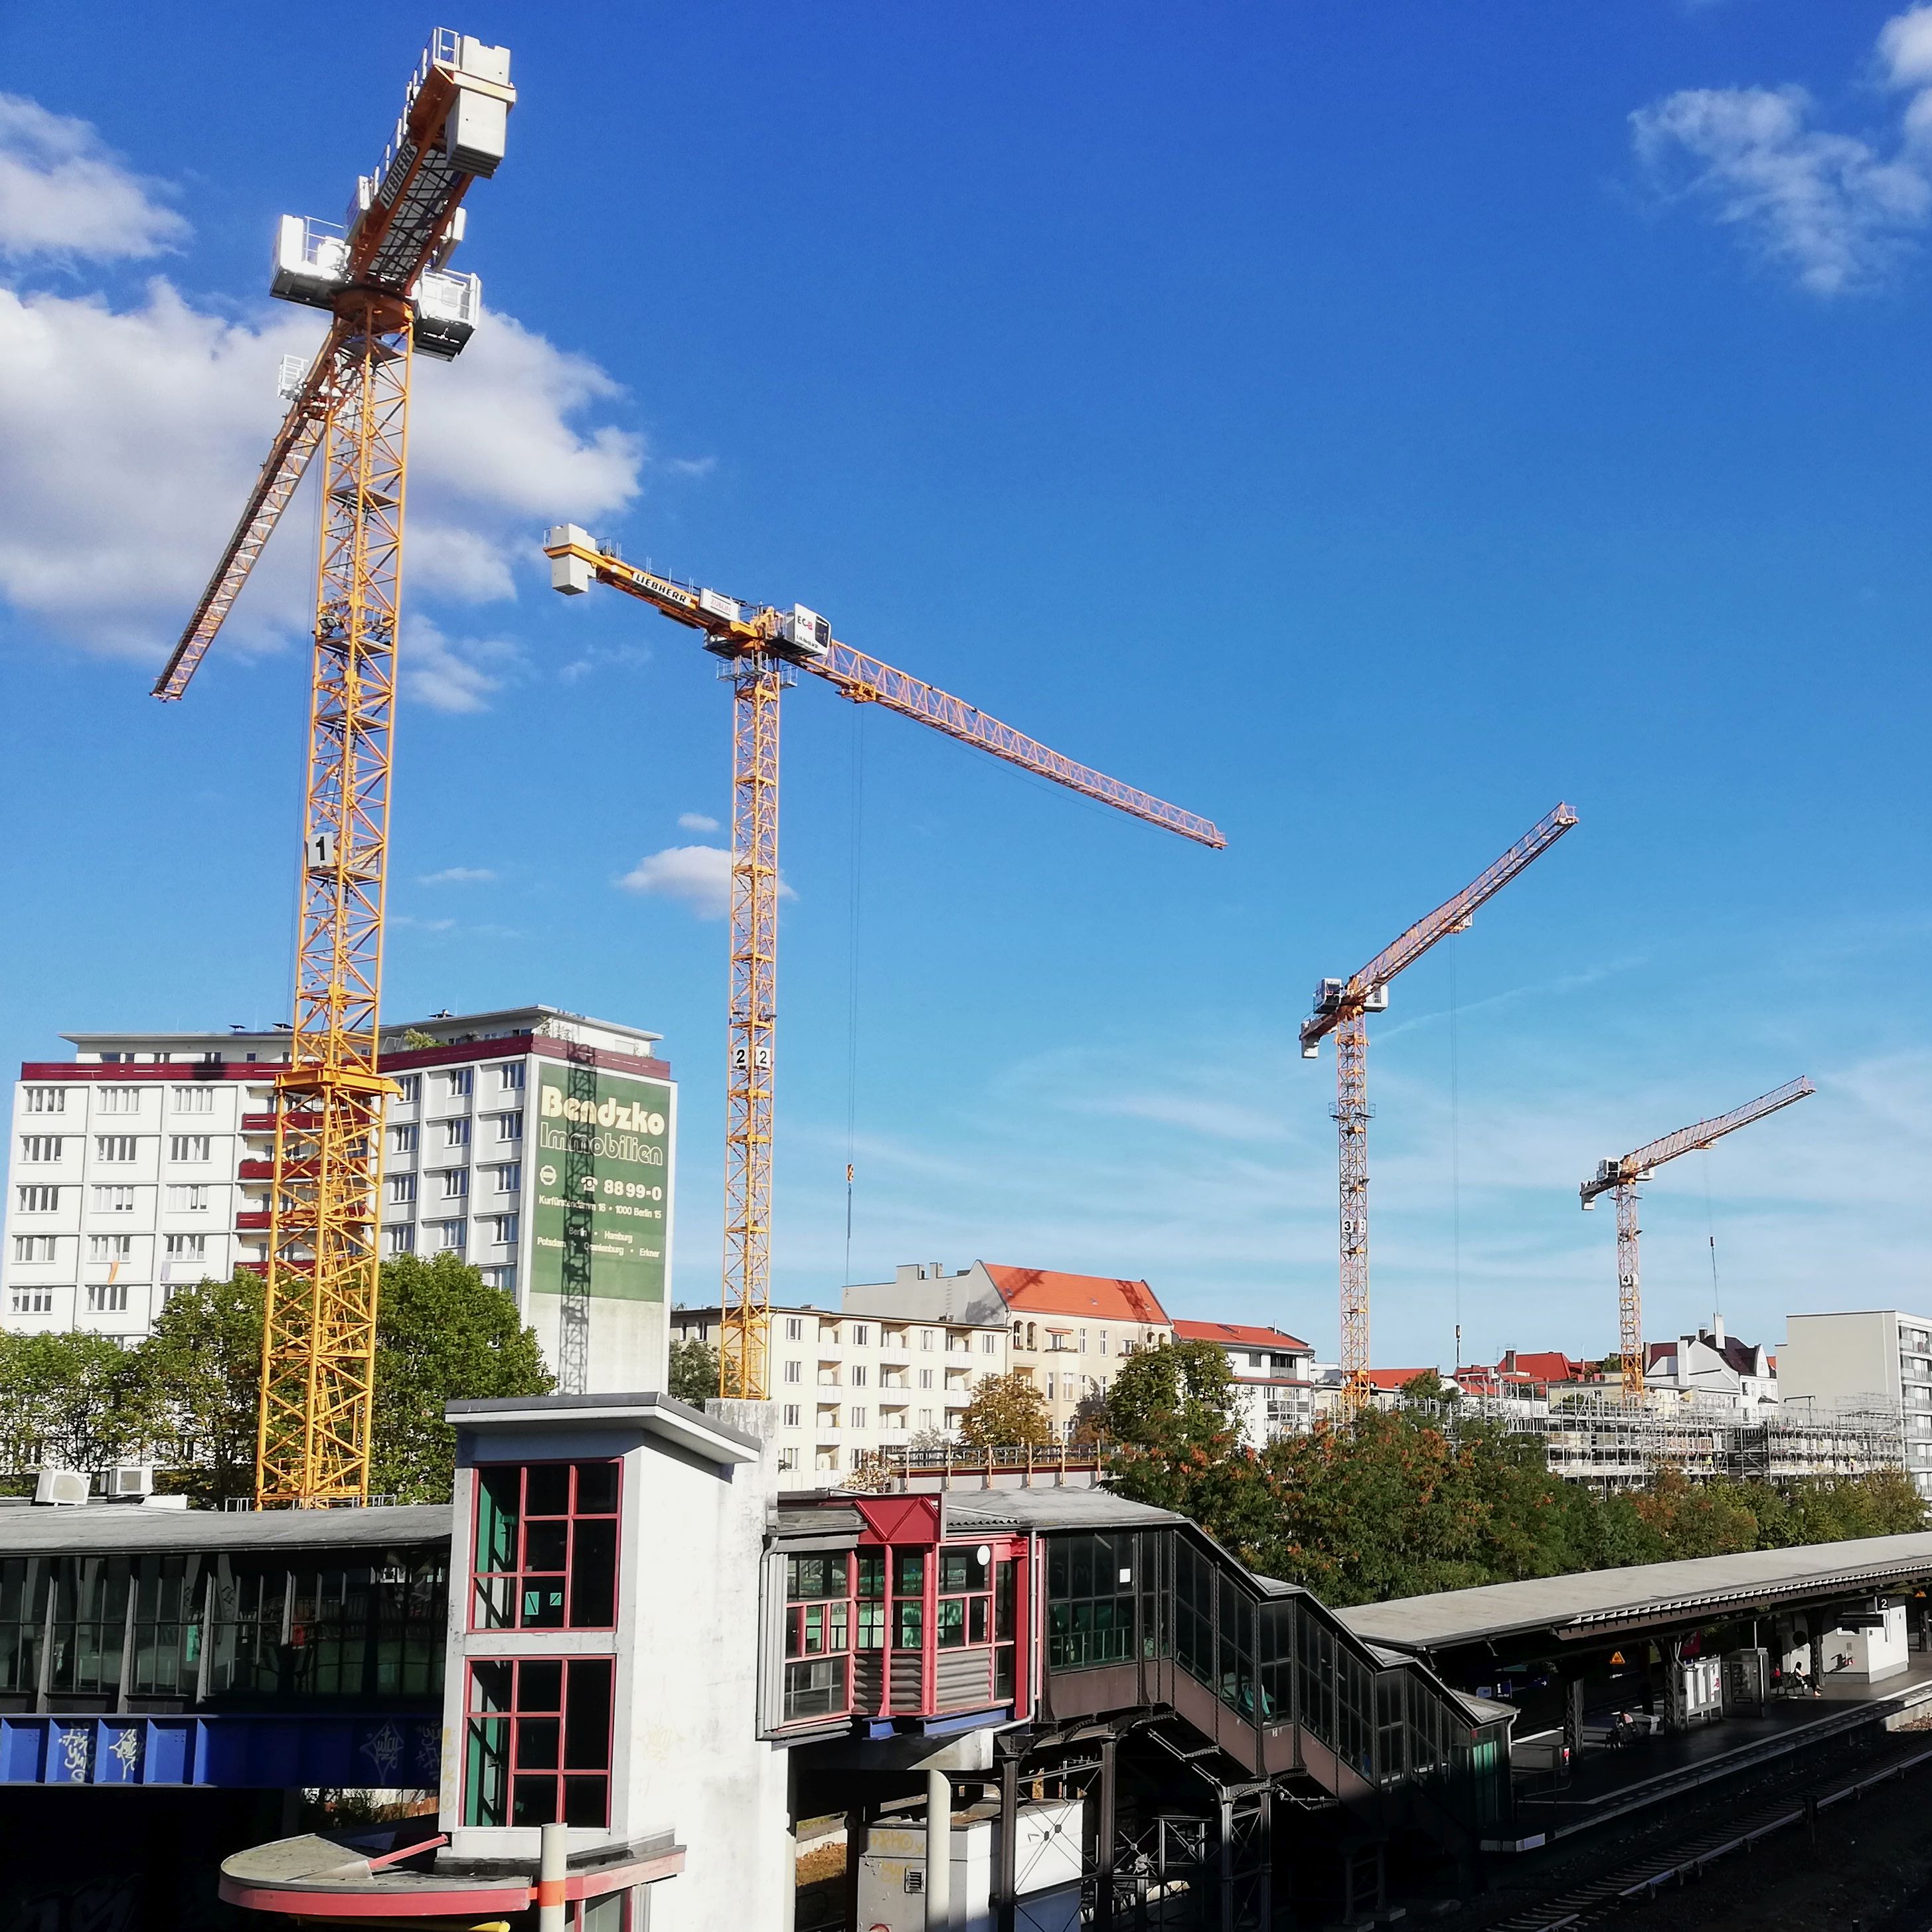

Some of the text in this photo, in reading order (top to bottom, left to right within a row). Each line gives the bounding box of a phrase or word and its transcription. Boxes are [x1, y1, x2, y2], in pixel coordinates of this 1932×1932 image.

[380, 143, 415, 206] LIEBHERR
[636, 574, 686, 603] LIEBHERR
[315, 836, 325, 861] 1
[736, 1049, 745, 1064] 2
[760, 1050, 767, 1064] 2
[541, 1085, 665, 1136] Bendzko
[540, 1121, 663, 1166] Immobilien
[538, 1194, 596, 1212] Kurfürstendamm
[615, 1205, 632, 1215] 1000
[633, 1207, 653, 1218] Berlin
[654, 1210, 662, 1220] 15
[568, 1226, 588, 1237] Berlin
[1344, 1221, 1351, 1230] 3
[1881, 1599, 1888, 1608] 2
